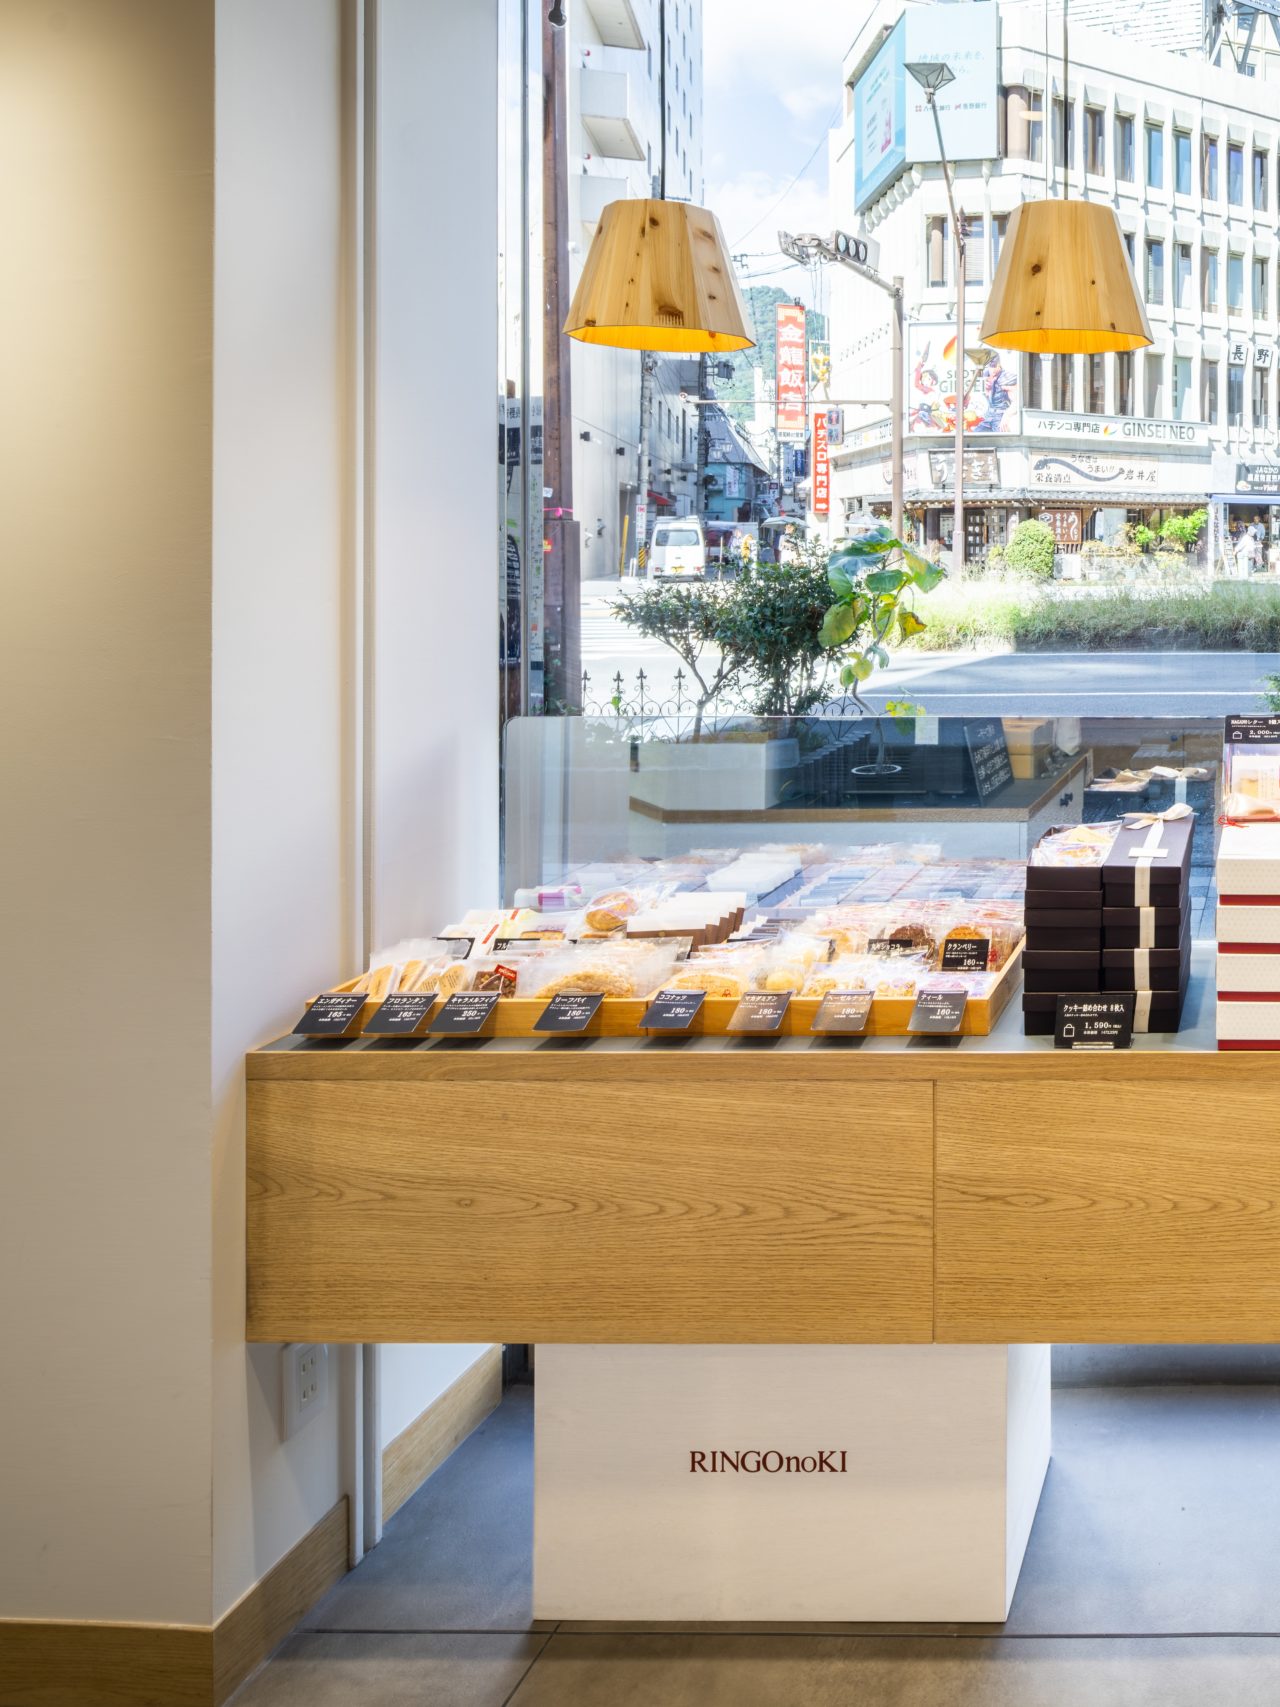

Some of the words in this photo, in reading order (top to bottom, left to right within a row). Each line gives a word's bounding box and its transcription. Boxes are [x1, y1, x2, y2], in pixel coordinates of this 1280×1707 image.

[939, 380, 987, 393] GISEI
[1122, 422, 1166, 438] GINSEI
[1169, 425, 1196, 440] NEO
[816, 417, 829, 498] パチスロ専門店
[387, 997, 426, 1005] フロランタン
[554, 996, 587, 1004] リーフパイ
[1063, 1004, 1108, 1012] クッキー詰め合わせ
[689, 1450, 848, 1473] RINGOnoKI
